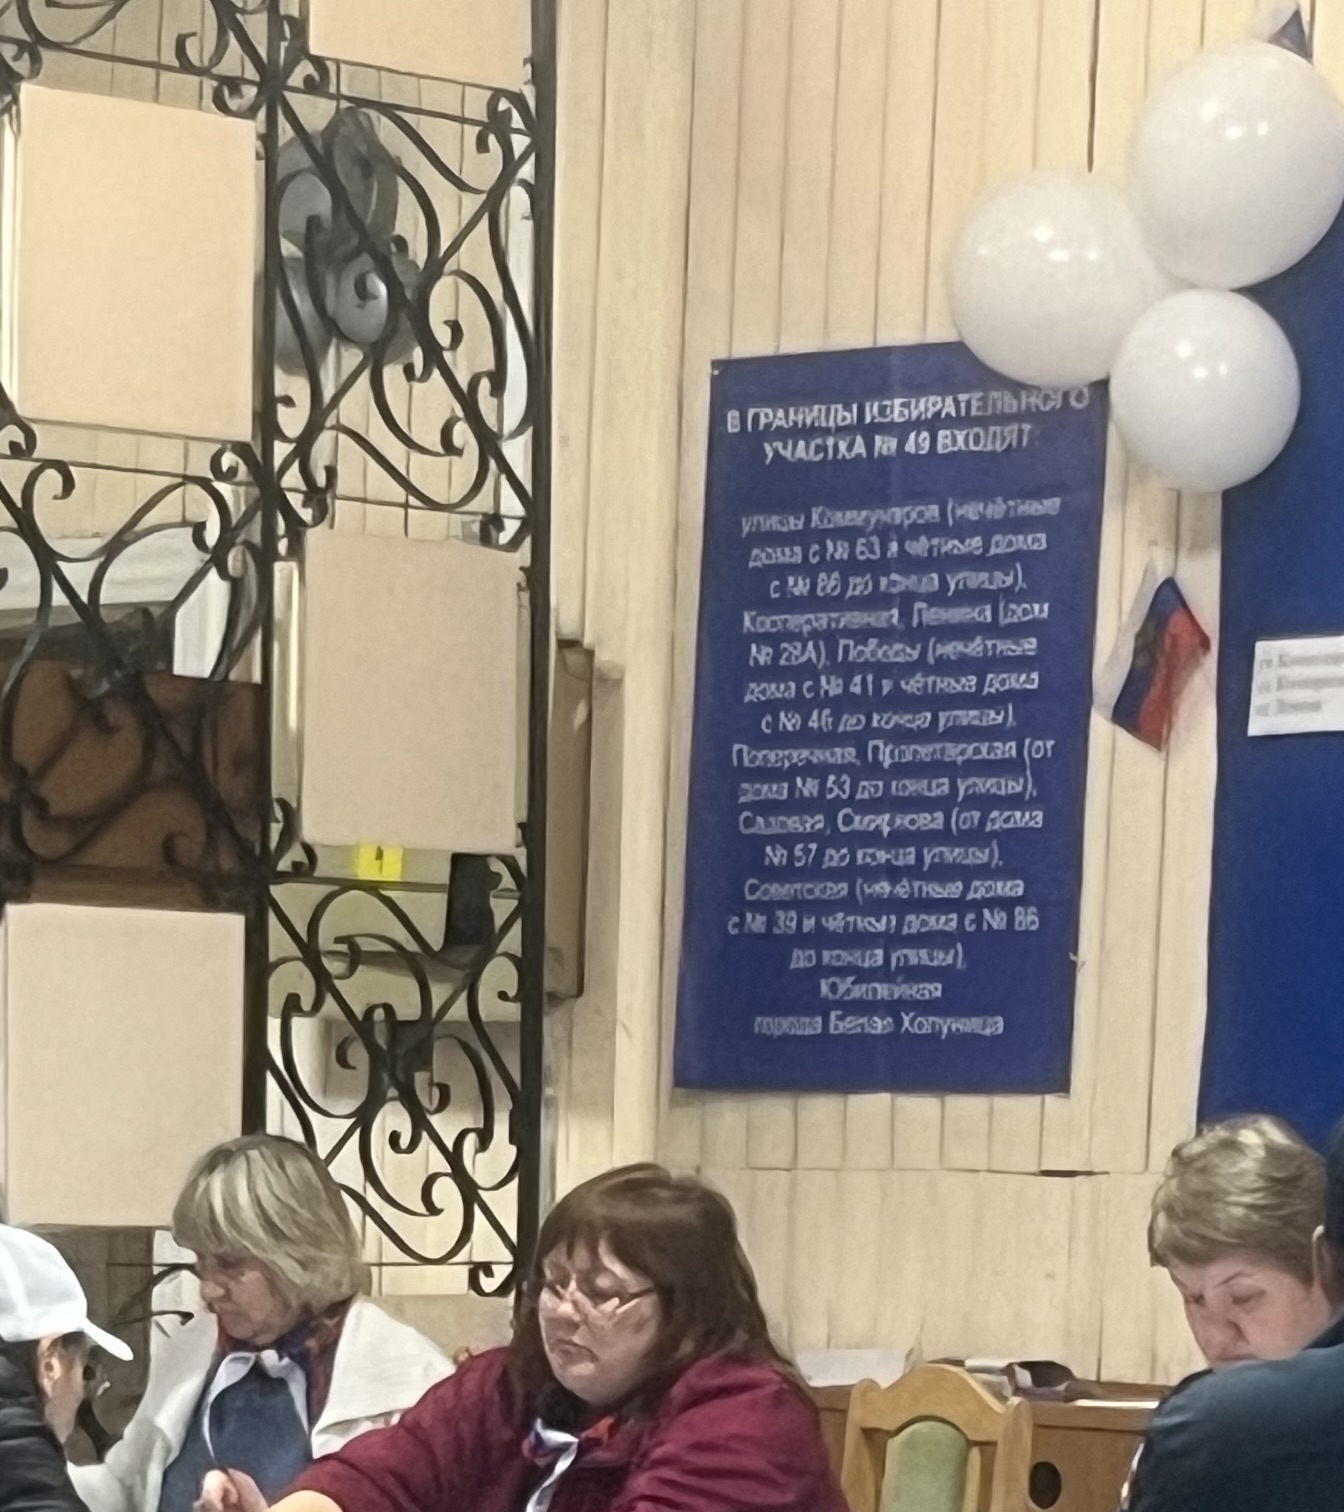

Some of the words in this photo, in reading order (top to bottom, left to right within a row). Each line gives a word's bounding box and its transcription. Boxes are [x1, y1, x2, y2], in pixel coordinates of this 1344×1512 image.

[727, 410, 741, 433] В
[747, 402, 858, 433] ГРАНИЦЫ
[864, 386, 1090, 424] ИЗБИРАТЕЛЬНОГО
[763, 434, 867, 465] УЧАСТКА
[874, 434, 898, 458] №
[904, 429, 931, 454] 49
[741, 513, 805, 538] улицы
[810, 504, 940, 533] Коммунаров
[947, 496, 1061, 528] (нечётные
[748, 545, 803, 568] дома
[808, 543, 820, 564] с
[825, 538, 849, 561] №
[855, 535, 881, 560] 63
[904, 535, 983, 557] чётные
[986, 532, 1047, 557] дома
[770, 580, 781, 598] с
[844, 573, 873, 600] до
[879, 572, 939, 594] конца
[912, 600, 992, 628] Ленина
[998, 592, 1049, 627] (дом
[749, 642, 774, 667] №
[837, 637, 922, 664] Победы
[927, 636, 1038, 665] (нечётные
[743, 681, 797, 704] дома
[802, 680, 815, 699] с
[849, 673, 873, 697] 41
[899, 672, 978, 696] чётные
[981, 671, 1040, 696] дома
[761, 713, 773, 734] с
[778, 710, 802, 732] №
[837, 712, 867, 733] до
[871, 711, 932, 731] конца
[867, 739, 1017, 770] Пролетарская
[1023, 737, 1056, 775] (от
[738, 782, 789, 805] дома
[855, 780, 884, 801] до
[891, 777, 950, 797] конца
[837, 807, 945, 838] Смирнова
[950, 806, 982, 837] (от
[984, 810, 1044, 833] дома
[764, 844, 788, 867] №
[822, 847, 850, 869] до
[856, 846, 916, 867] конца
[744, 877, 849, 901] Советская
[856, 877, 964, 905] (нечётные
[965, 879, 1025, 901] дома
[727, 915, 740, 935] с
[772, 909, 798, 935] 39
[802, 915, 816, 934] и
[901, 912, 958, 936] дома
[964, 912, 976, 932] с
[982, 907, 1007, 932] №
[789, 948, 817, 969] до
[822, 948, 884, 969] конца
[820, 975, 943, 1001] Юбилейная
[829, 1010, 895, 1035] Белая
[901, 1011, 1005, 1040] Холуница
